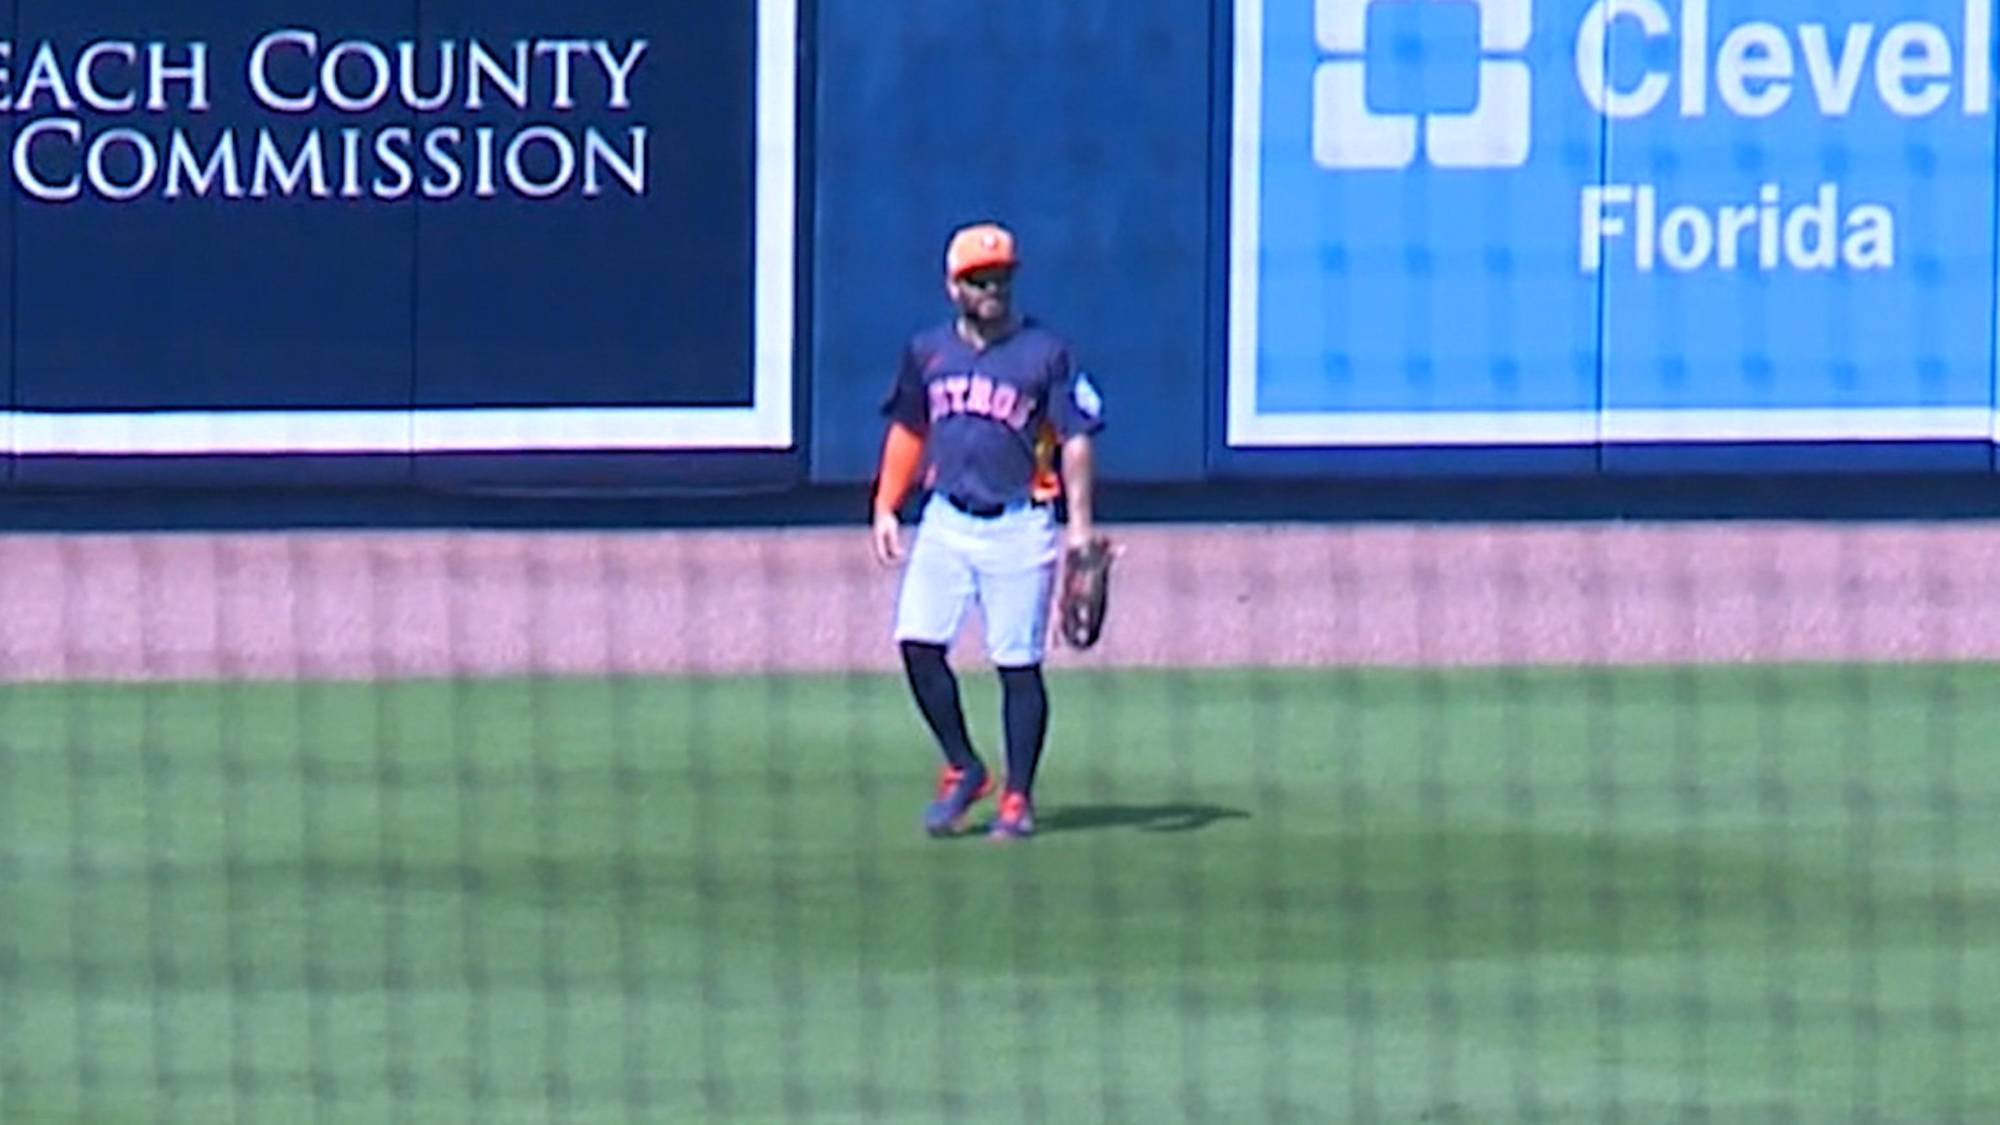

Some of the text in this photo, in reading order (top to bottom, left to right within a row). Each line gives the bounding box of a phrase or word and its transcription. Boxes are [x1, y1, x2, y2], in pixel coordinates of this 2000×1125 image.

[249, 31, 646, 111] COUNTY
[1576, 0, 1990, 118] Clevel
[12, 118, 646, 199] COMMISSION
[1580, 184, 1893, 271] Florida
